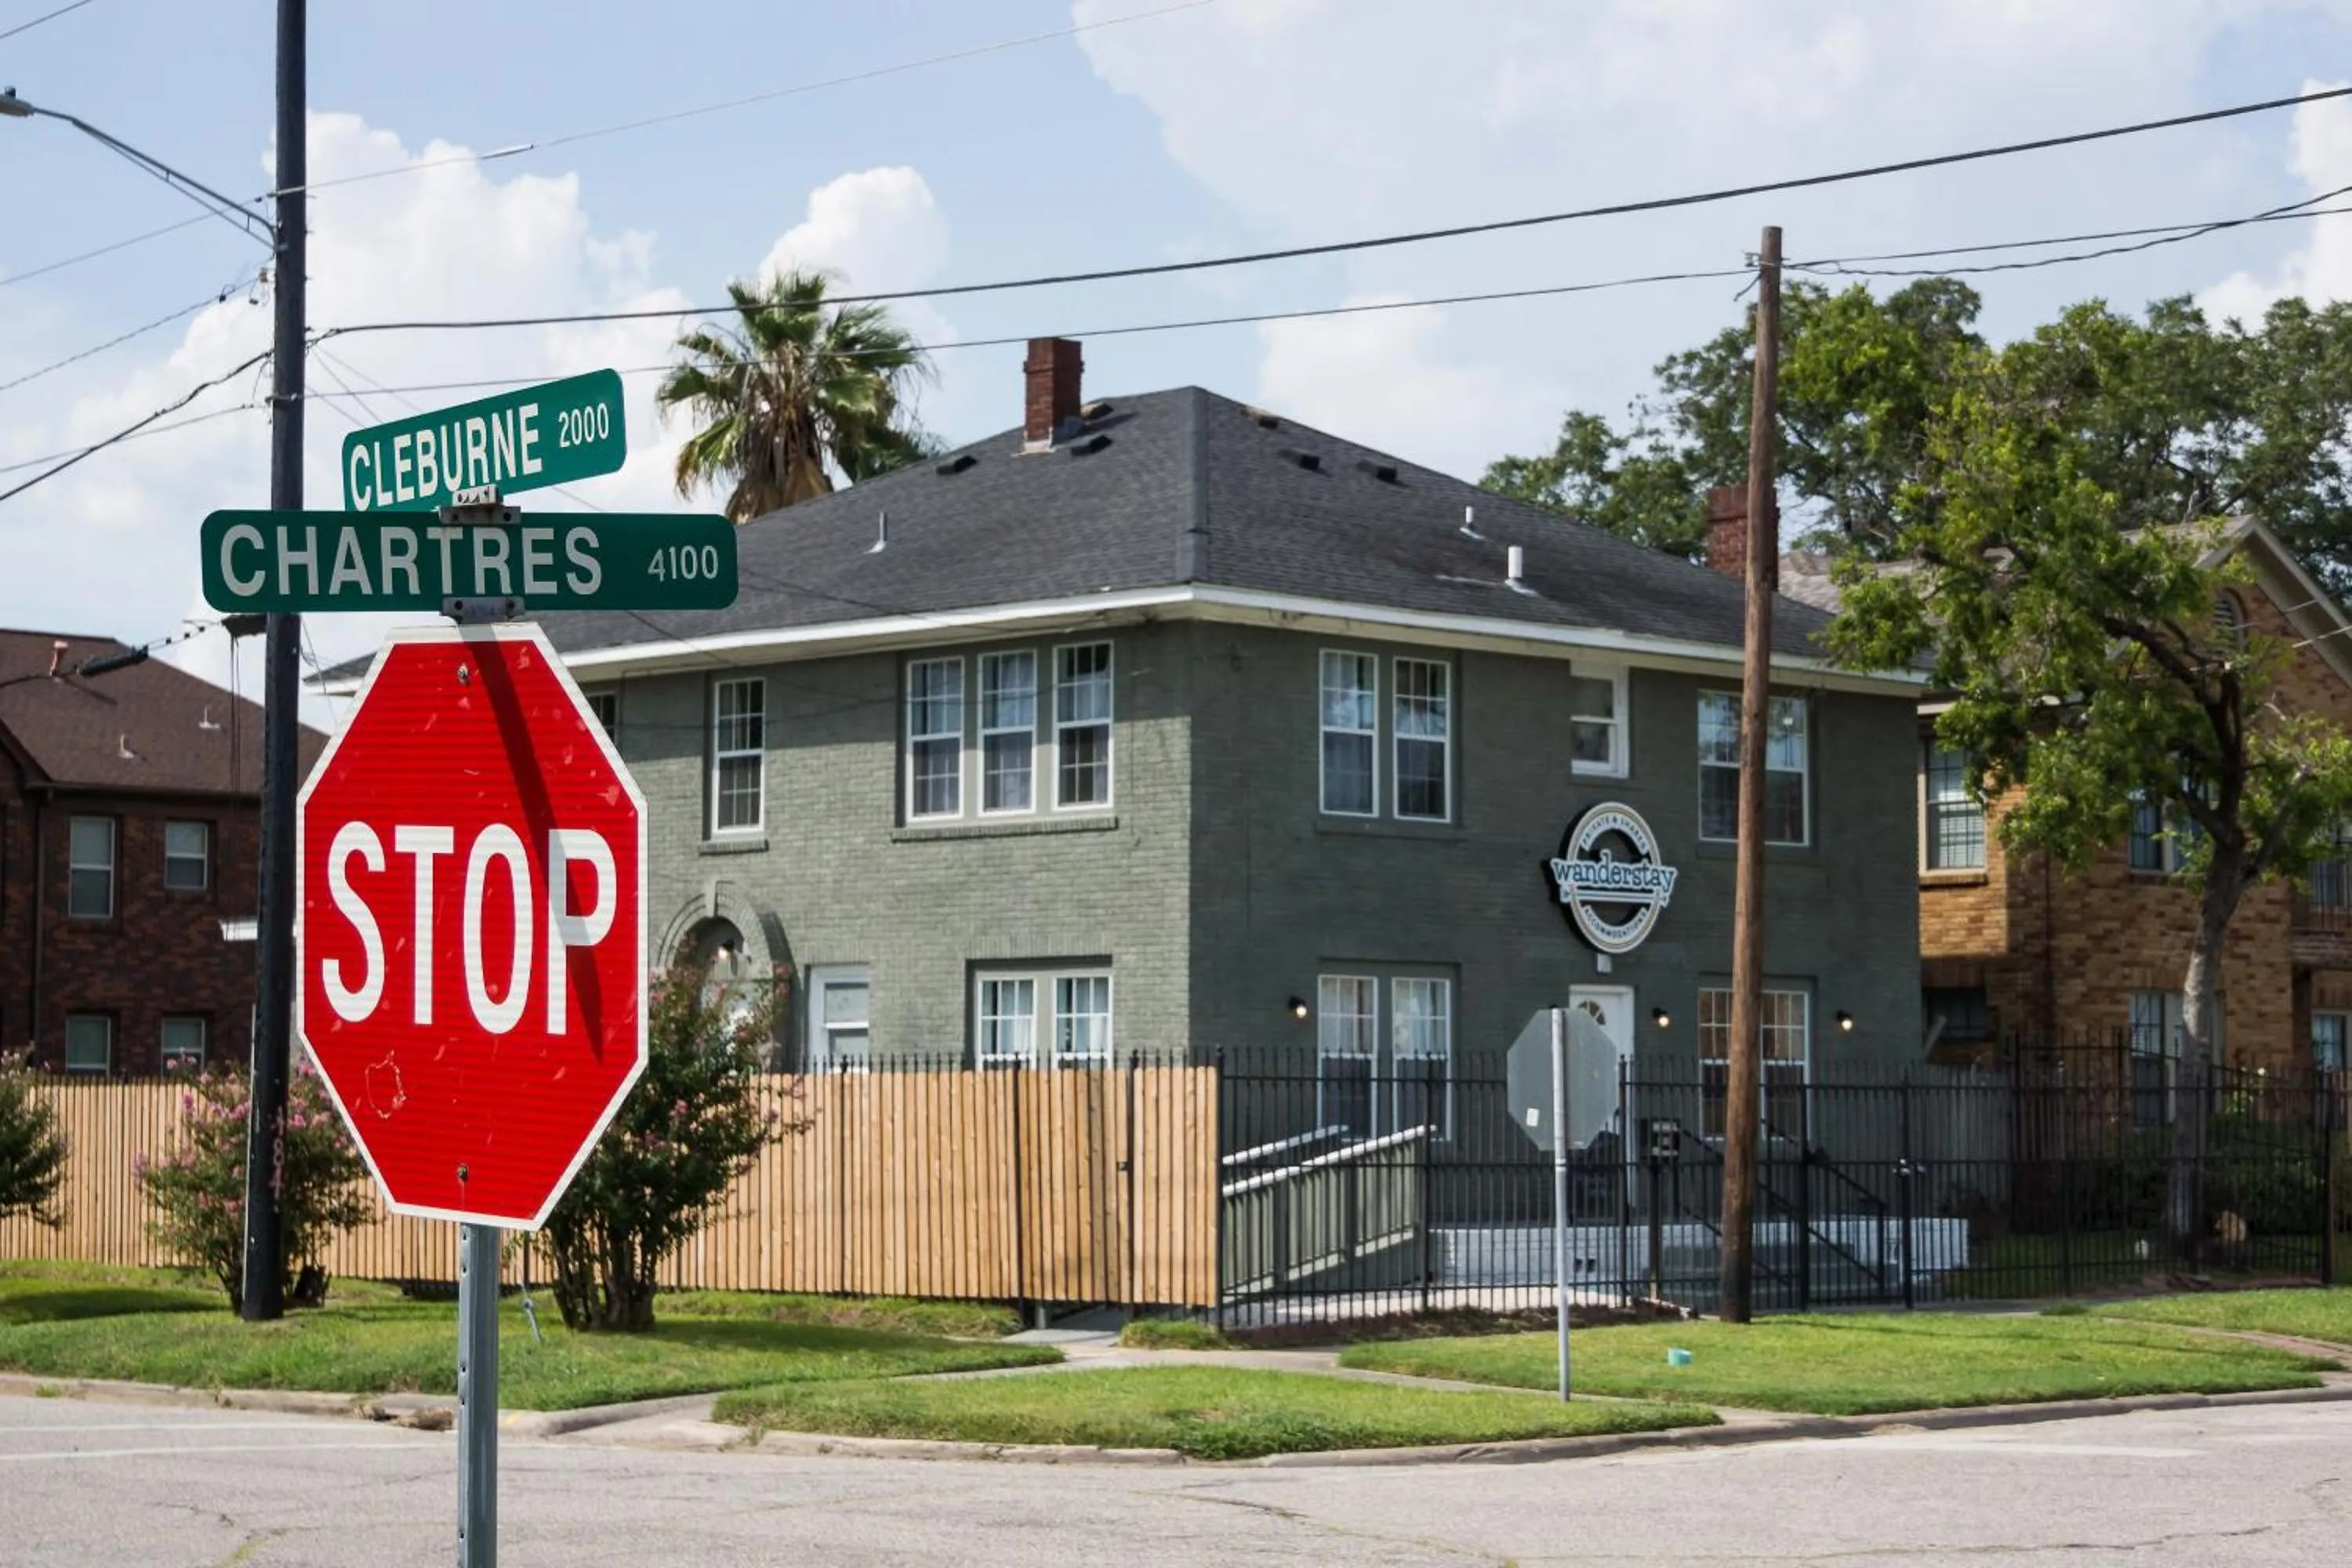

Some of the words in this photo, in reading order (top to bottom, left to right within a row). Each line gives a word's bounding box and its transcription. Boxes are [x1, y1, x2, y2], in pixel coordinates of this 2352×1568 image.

[350, 401, 543, 513] CLEBURNE
[557, 401, 610, 449] 2000
[220, 523, 602, 596] CHARTRES
[647, 545, 719, 583] 4100
[1553, 851, 1675, 893] wanderstay
[321, 820, 617, 1036] STOP
